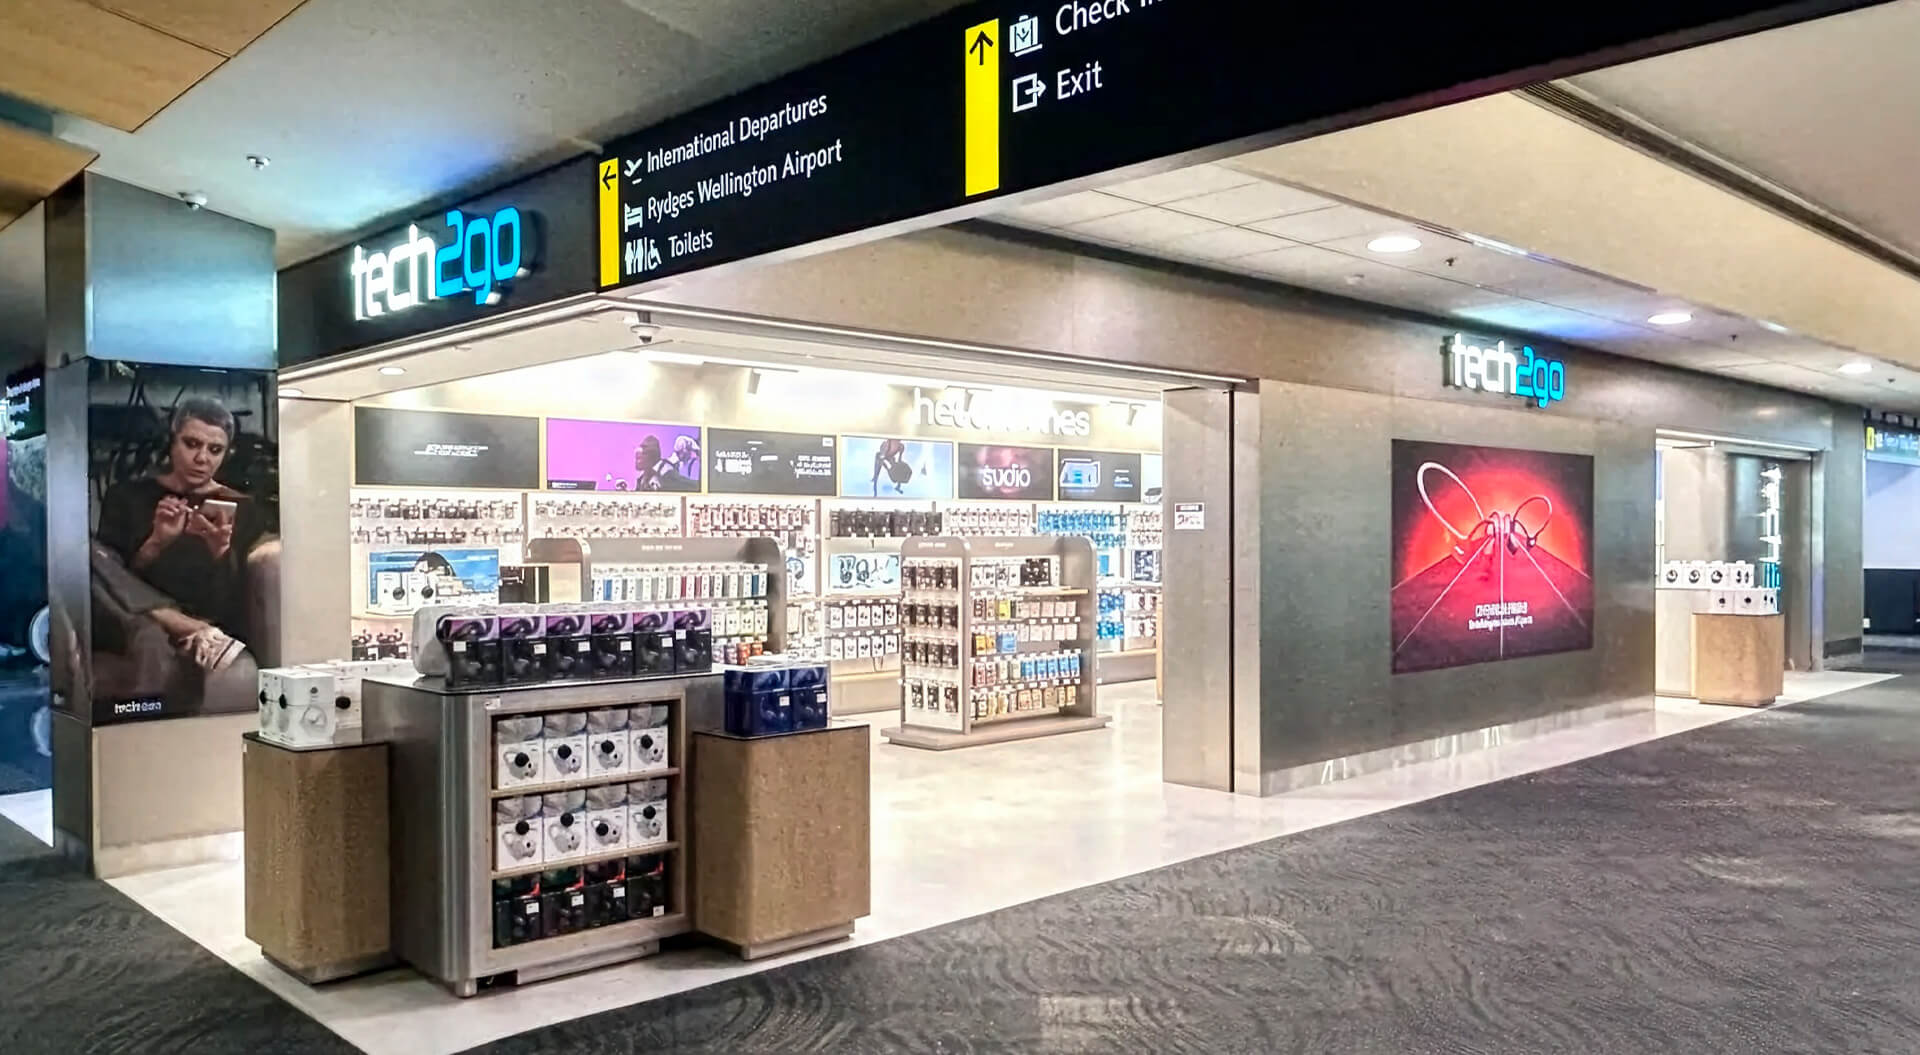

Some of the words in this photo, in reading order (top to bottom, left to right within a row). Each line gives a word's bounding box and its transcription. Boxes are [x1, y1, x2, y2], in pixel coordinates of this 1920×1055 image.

[1057, 61, 1103, 100] Exit
[740, 95, 828, 142] Departures
[648, 190, 694, 223] Rydges
[697, 165, 777, 197] Wellington
[782, 138, 842, 178] Airport
[351, 207, 521, 321] tech2go
[668, 229, 713, 258] Toilets
[1452, 333, 1565, 408] tech2go
